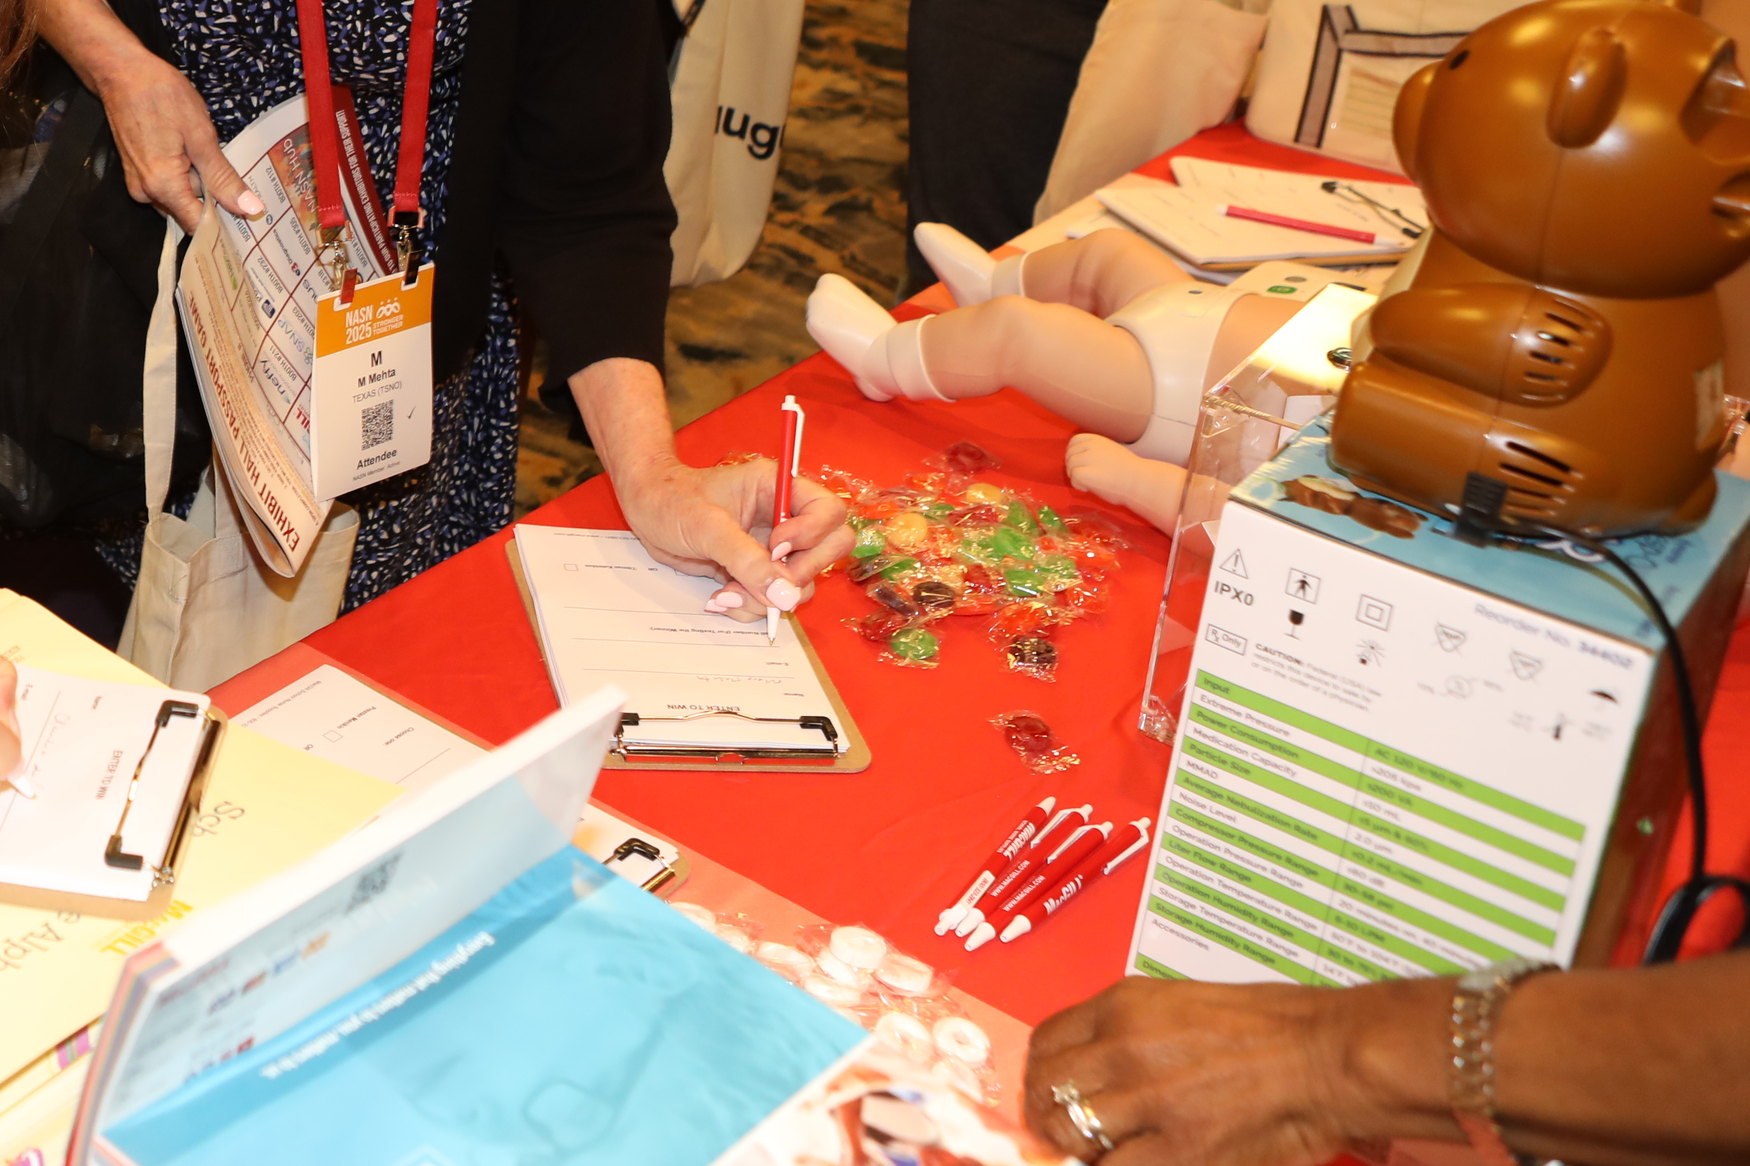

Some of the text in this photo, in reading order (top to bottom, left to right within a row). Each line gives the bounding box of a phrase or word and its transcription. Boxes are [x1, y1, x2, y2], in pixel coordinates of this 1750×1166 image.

[342, 137, 355, 156] THEIR
[349, 154, 358, 169] FOR
[283, 138, 318, 213] NASN Hub
[352, 163, 369, 204] EXHIBITORS
[273, 183, 286, 203] BOOTH
[236, 220, 251, 242] BOOTH
[364, 202, 388, 253] PARTICIPATING
[273, 229, 293, 265] Diagnostics
[298, 235, 311, 255] BOOTH
[381, 246, 391, 260] OUR
[257, 257, 271, 275] #232
[354, 249, 368, 268] BOOTH
[268, 274, 283, 294] BOOTH
[188, 290, 209, 344] GAME
[345, 304, 373, 327] NASN
[373, 314, 403, 329] STRONGER
[373, 322, 403, 335] TOGETHER
[346, 322, 372, 344] 2025
[280, 359, 297, 381] BOOTH
[371, 350, 382, 368] M
[260, 359, 286, 396] neffy
[358, 368, 396, 388] M Mehta
[204, 352, 240, 439] PASSPORT
[352, 381, 402, 404] TEXAS (TSNO)
[236, 439, 260, 482] HALL
[356, 449, 397, 470] Attendee
[257, 483, 301, 552] EXHIBIT
[1214, 581, 1254, 606] IPX0
[1221, 634, 1242, 648] Only
[1255, 643, 1304, 667] CAUTION:
[1203, 677, 1231, 695] Input
[707, 704, 740, 712] ENTER
[1200, 694, 1291, 738] Extreme Pressure
[394, 726, 415, 740] Choose
[1196, 710, 1300, 760] Power Consumption
[107, 749, 123, 775] ENTER
[1189, 743, 1252, 776] Particle Size
[1193, 727, 1297, 778] Medication Capacity
[1186, 760, 1218, 780] MMAD
[95, 785, 108, 800] WIN
[191, 800, 245, 838] Sch
[1179, 791, 1238, 823] Noise Level
[1183, 777, 1319, 841] Average Nebulization Rate
[1175, 808, 1237, 840] Compressor
[1238, 834, 1283, 862] Pressure
[1284, 856, 1319, 877] Range
[1168, 840, 1253, 883] Liter Flow Range
[1172, 825, 1304, 889] Operation Pressure Range
[990, 860, 1030, 898] WWW.MACGILL.COM
[1002, 875, 1046, 912] WWW.MACGILL.COM
[1161, 871, 1295, 938] Operation Humidity Range
[1165, 856, 1318, 932] Operation Temperature Range
[1152, 918, 1210, 952] Accessories
[1155, 902, 1276, 965] Storage Humidity Range
[1158, 887, 1299, 958] Storage Temperature Range
